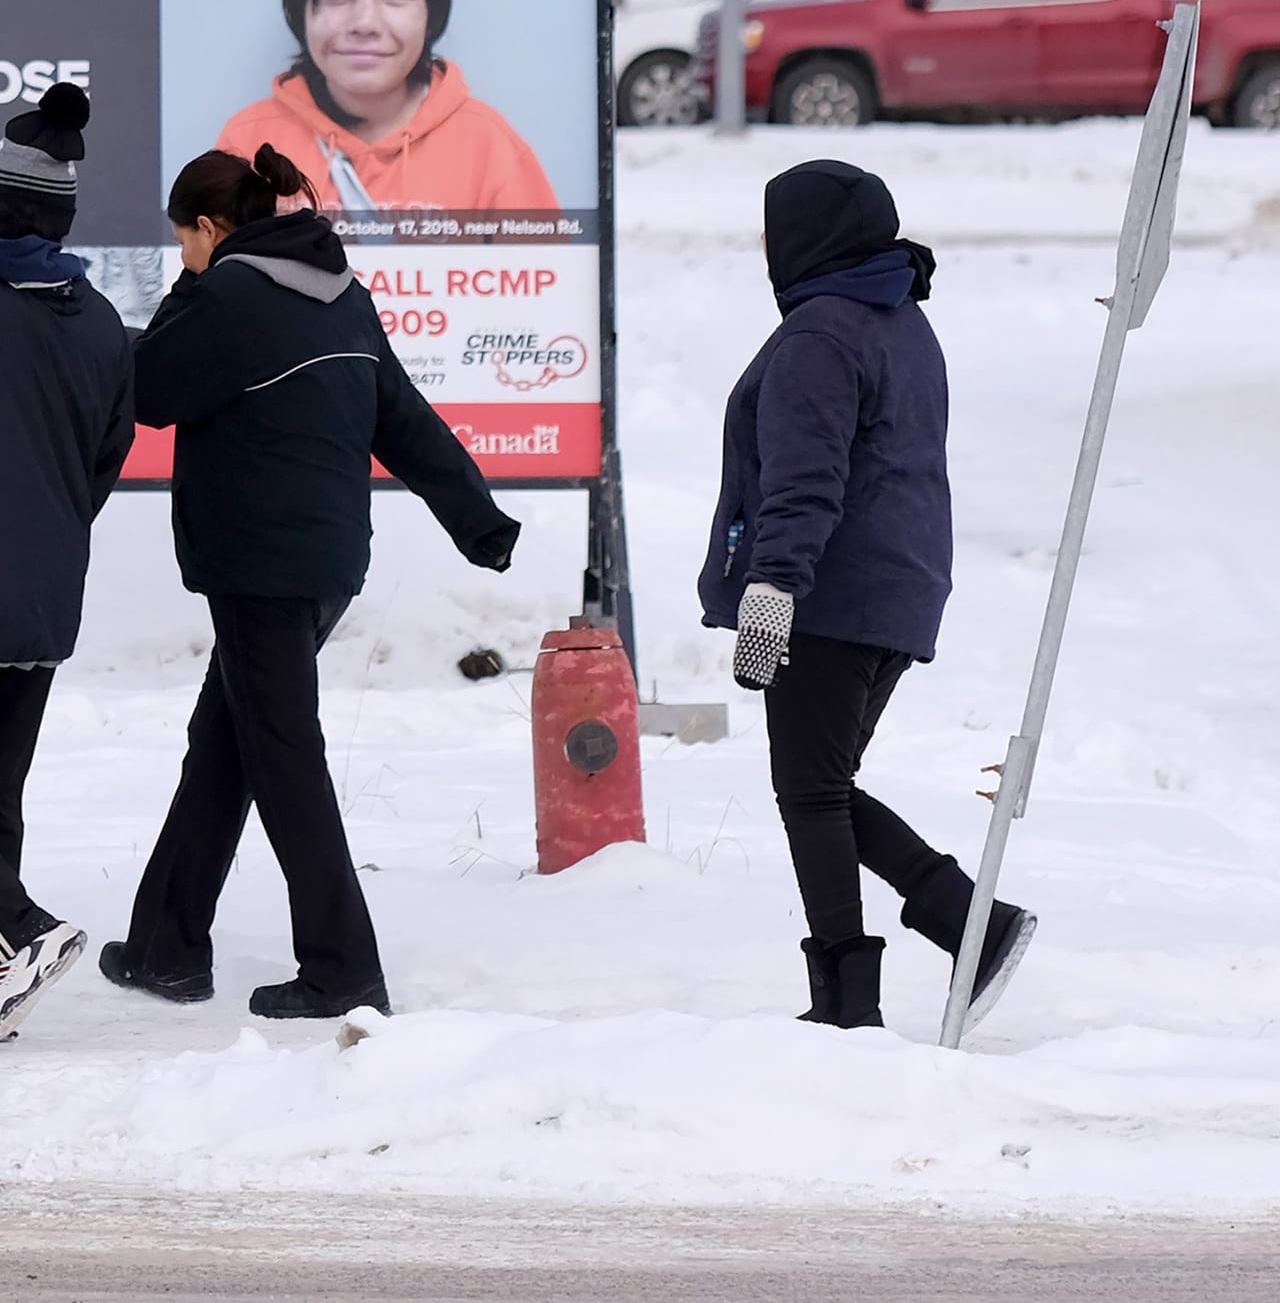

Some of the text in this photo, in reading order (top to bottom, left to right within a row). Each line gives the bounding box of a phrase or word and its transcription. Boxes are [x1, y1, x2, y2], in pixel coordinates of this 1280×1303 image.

[334, 218, 583, 237] October 17, 2019, near Nelson Rd.
[447, 270, 557, 296] RCMP
[466, 334, 540, 349] CRIME
[461, 350, 575, 365] STOPPERS
